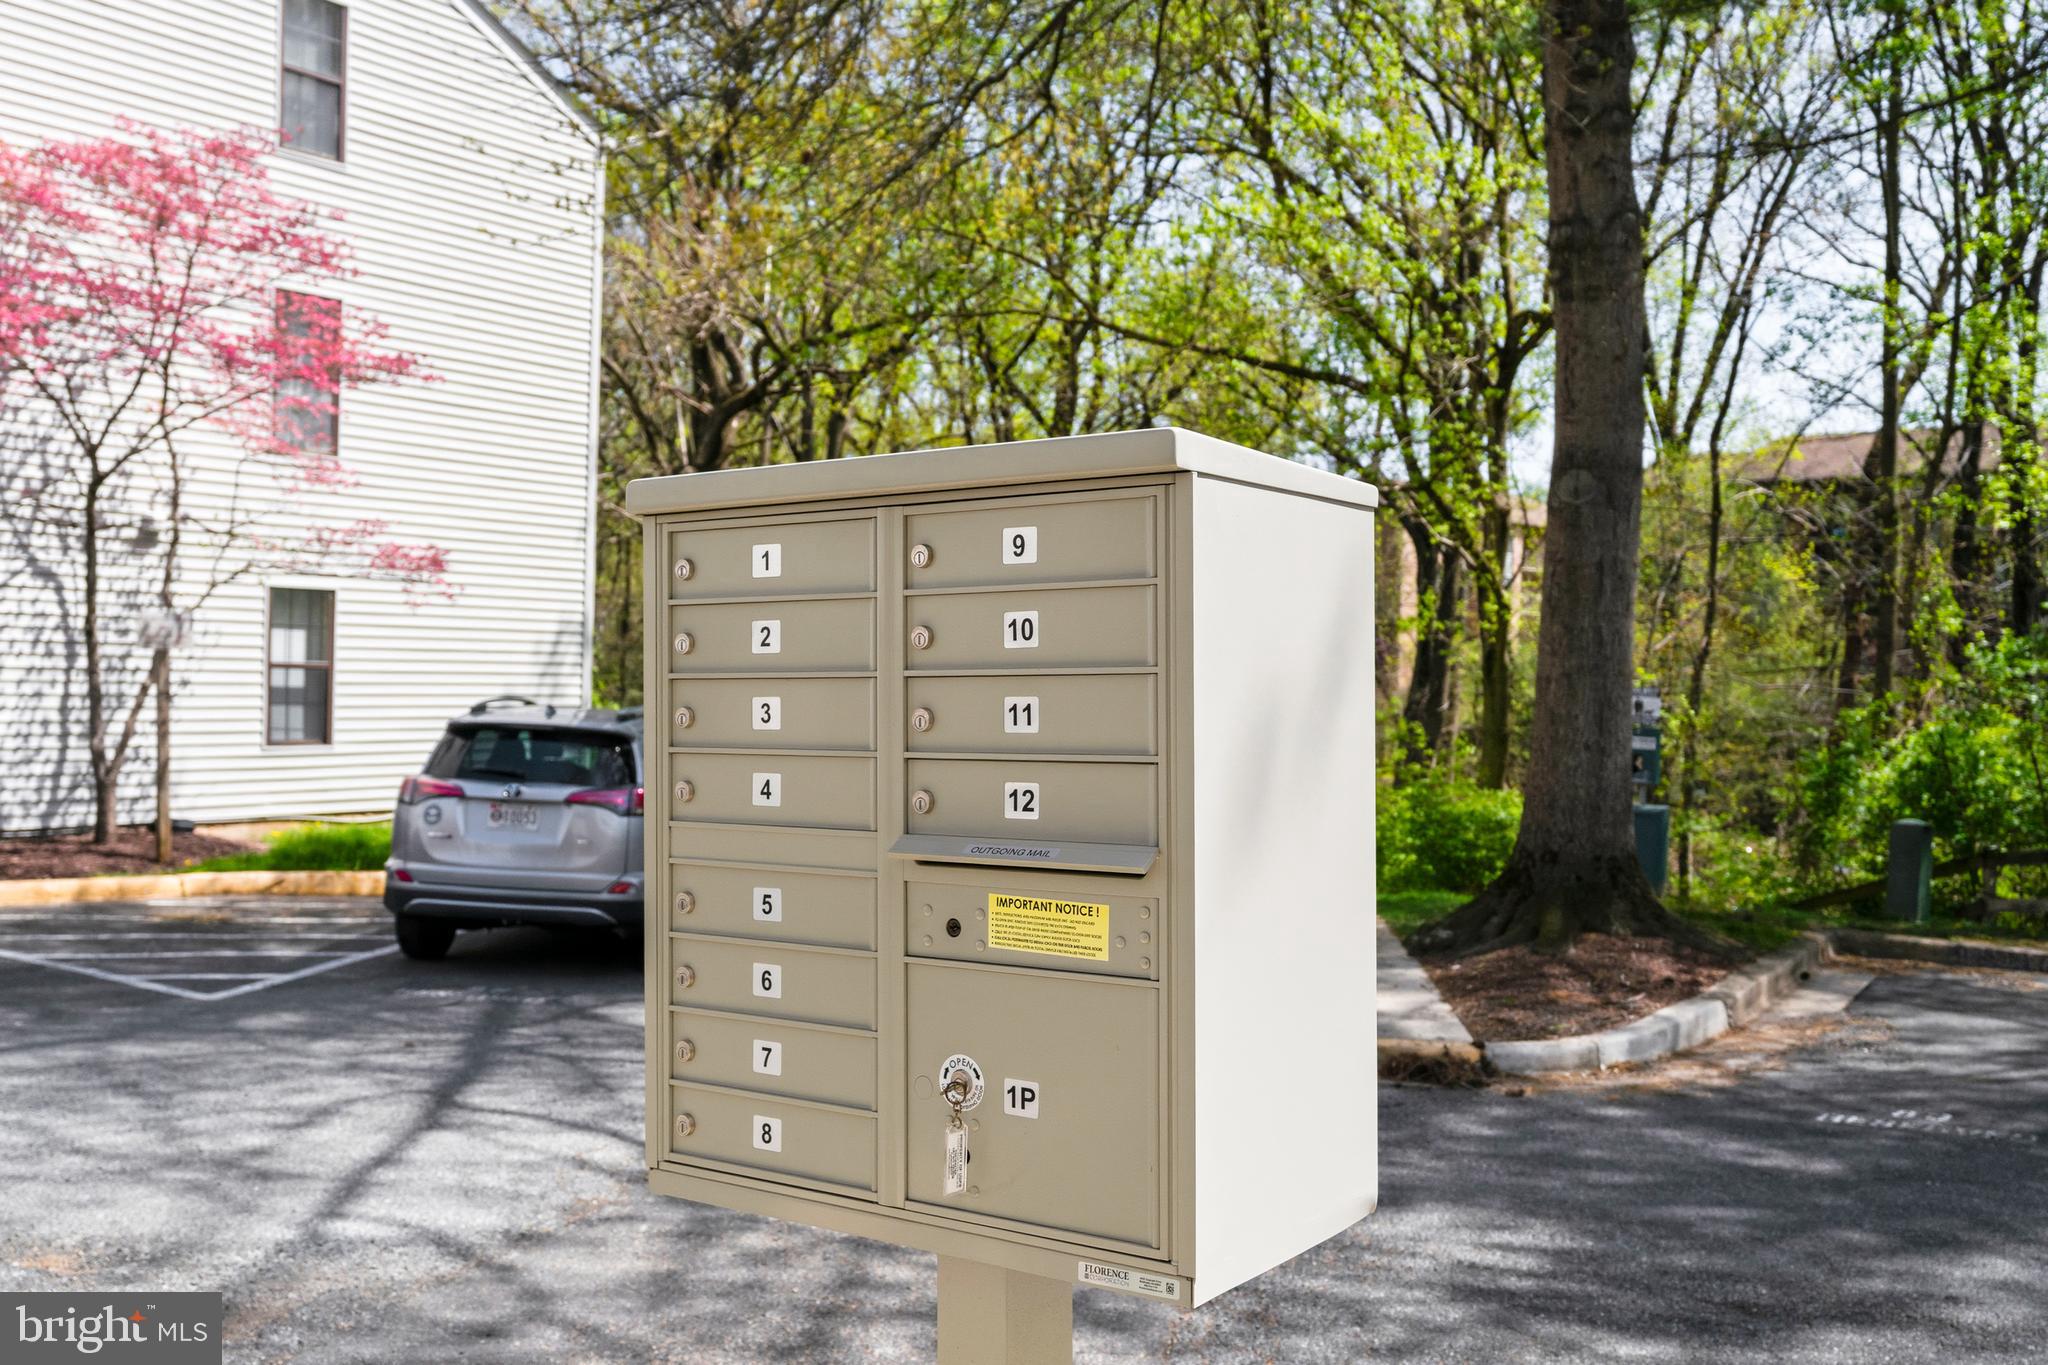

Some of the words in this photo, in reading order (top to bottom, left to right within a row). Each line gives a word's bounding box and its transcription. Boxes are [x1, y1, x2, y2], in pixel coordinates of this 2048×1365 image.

[1012, 534, 1026, 558] 9
[761, 550, 769, 571] 1
[760, 626, 771, 647] 2
[1008, 618, 1034, 642] 10
[760, 702, 771, 724] 3
[1008, 703, 1033, 727] 11
[760, 779, 772, 800] 4
[1008, 788, 1035, 813] 12
[970, 846, 1026, 857] OUTGOING
[1026, 848, 1051, 858] MAIL
[761, 893, 773, 915] 5
[996, 896, 1053, 913] IMPORTANT
[1055, 903, 1094, 918] NOTICE
[761, 970, 772, 992] 6
[761, 1046, 772, 1068] 7
[949, 1057, 974, 1070] OPEN
[1006, 1085, 1036, 1110] 1P
[761, 1122, 772, 1144] 8
[1084, 1264, 1130, 1281] FLORENCE
